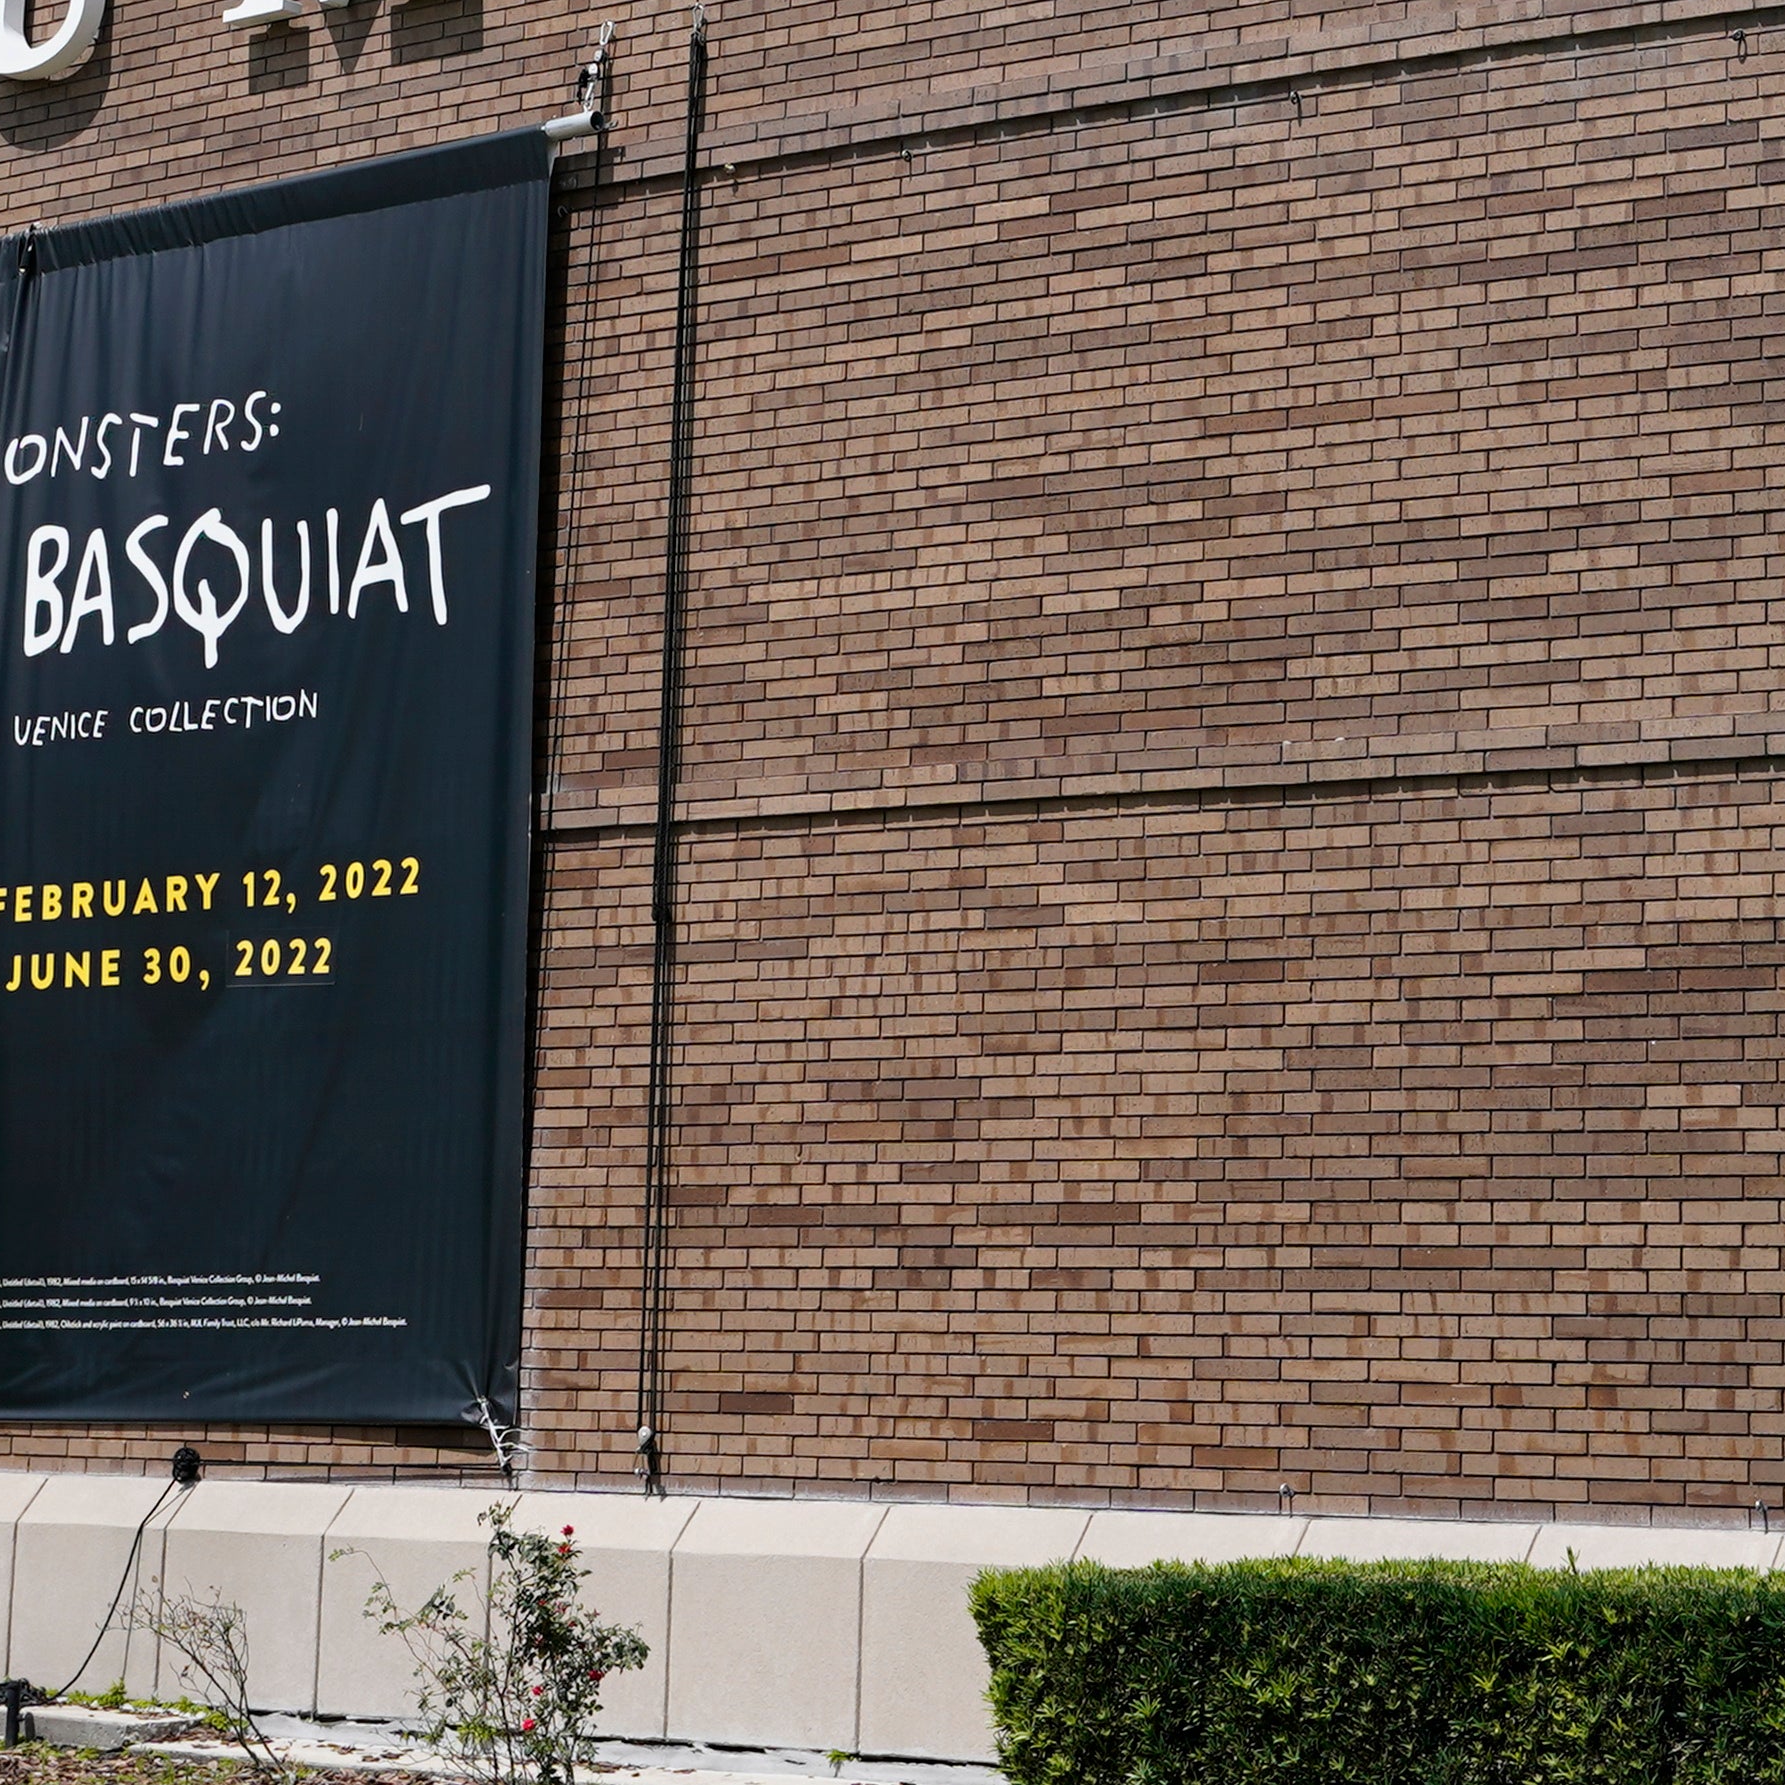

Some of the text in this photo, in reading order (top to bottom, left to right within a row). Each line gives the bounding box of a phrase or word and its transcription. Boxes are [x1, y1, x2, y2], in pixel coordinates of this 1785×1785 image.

[23, 483, 492, 669] BASQUIAT
[129, 688, 319, 733] COLLECTION
[242, 869, 297, 914] 12,
[318, 856, 421, 903] 2022
[5, 949, 121, 992] JUNE
[142, 945, 211, 991] 30,
[234, 937, 333, 977] 2022
